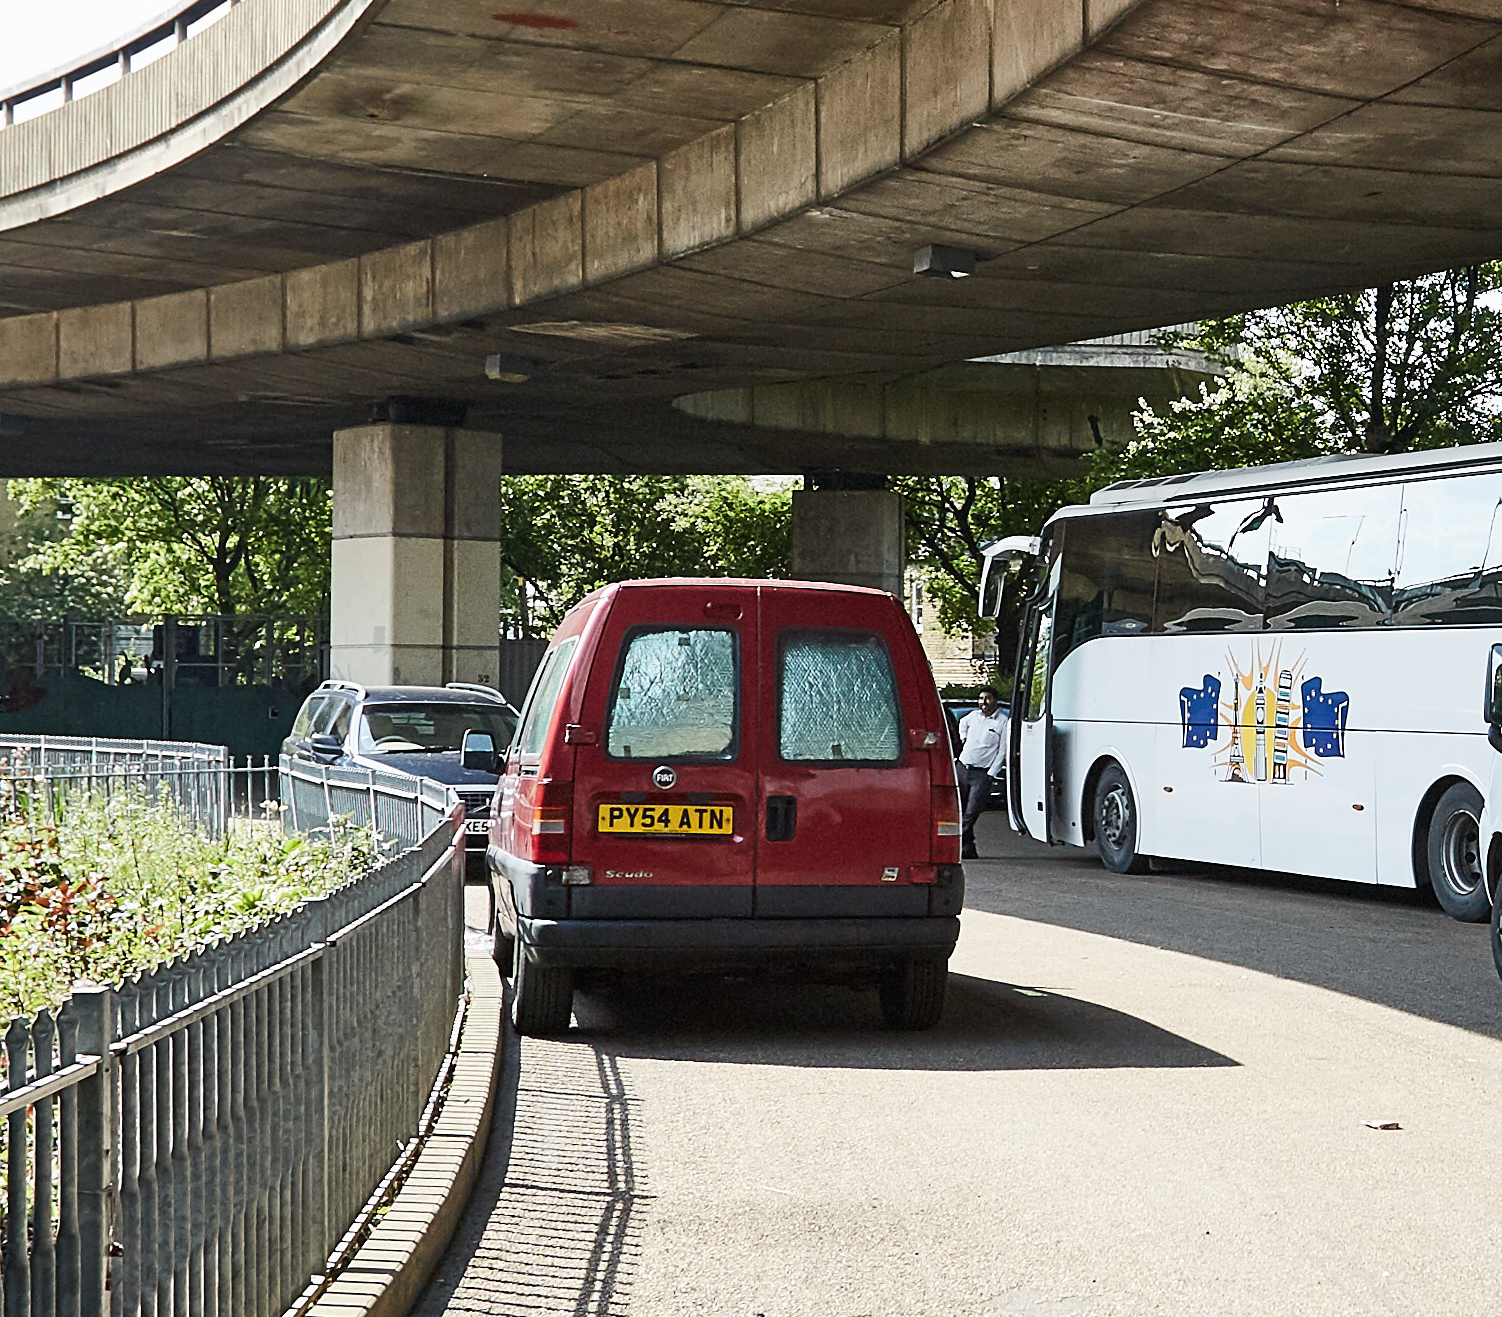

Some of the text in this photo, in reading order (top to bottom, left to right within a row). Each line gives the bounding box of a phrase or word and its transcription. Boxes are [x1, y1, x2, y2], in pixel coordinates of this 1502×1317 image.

[656, 773, 674, 782] FIAT
[608, 807, 724, 830] PY54 ATN
[605, 870, 653, 878] Scudo
